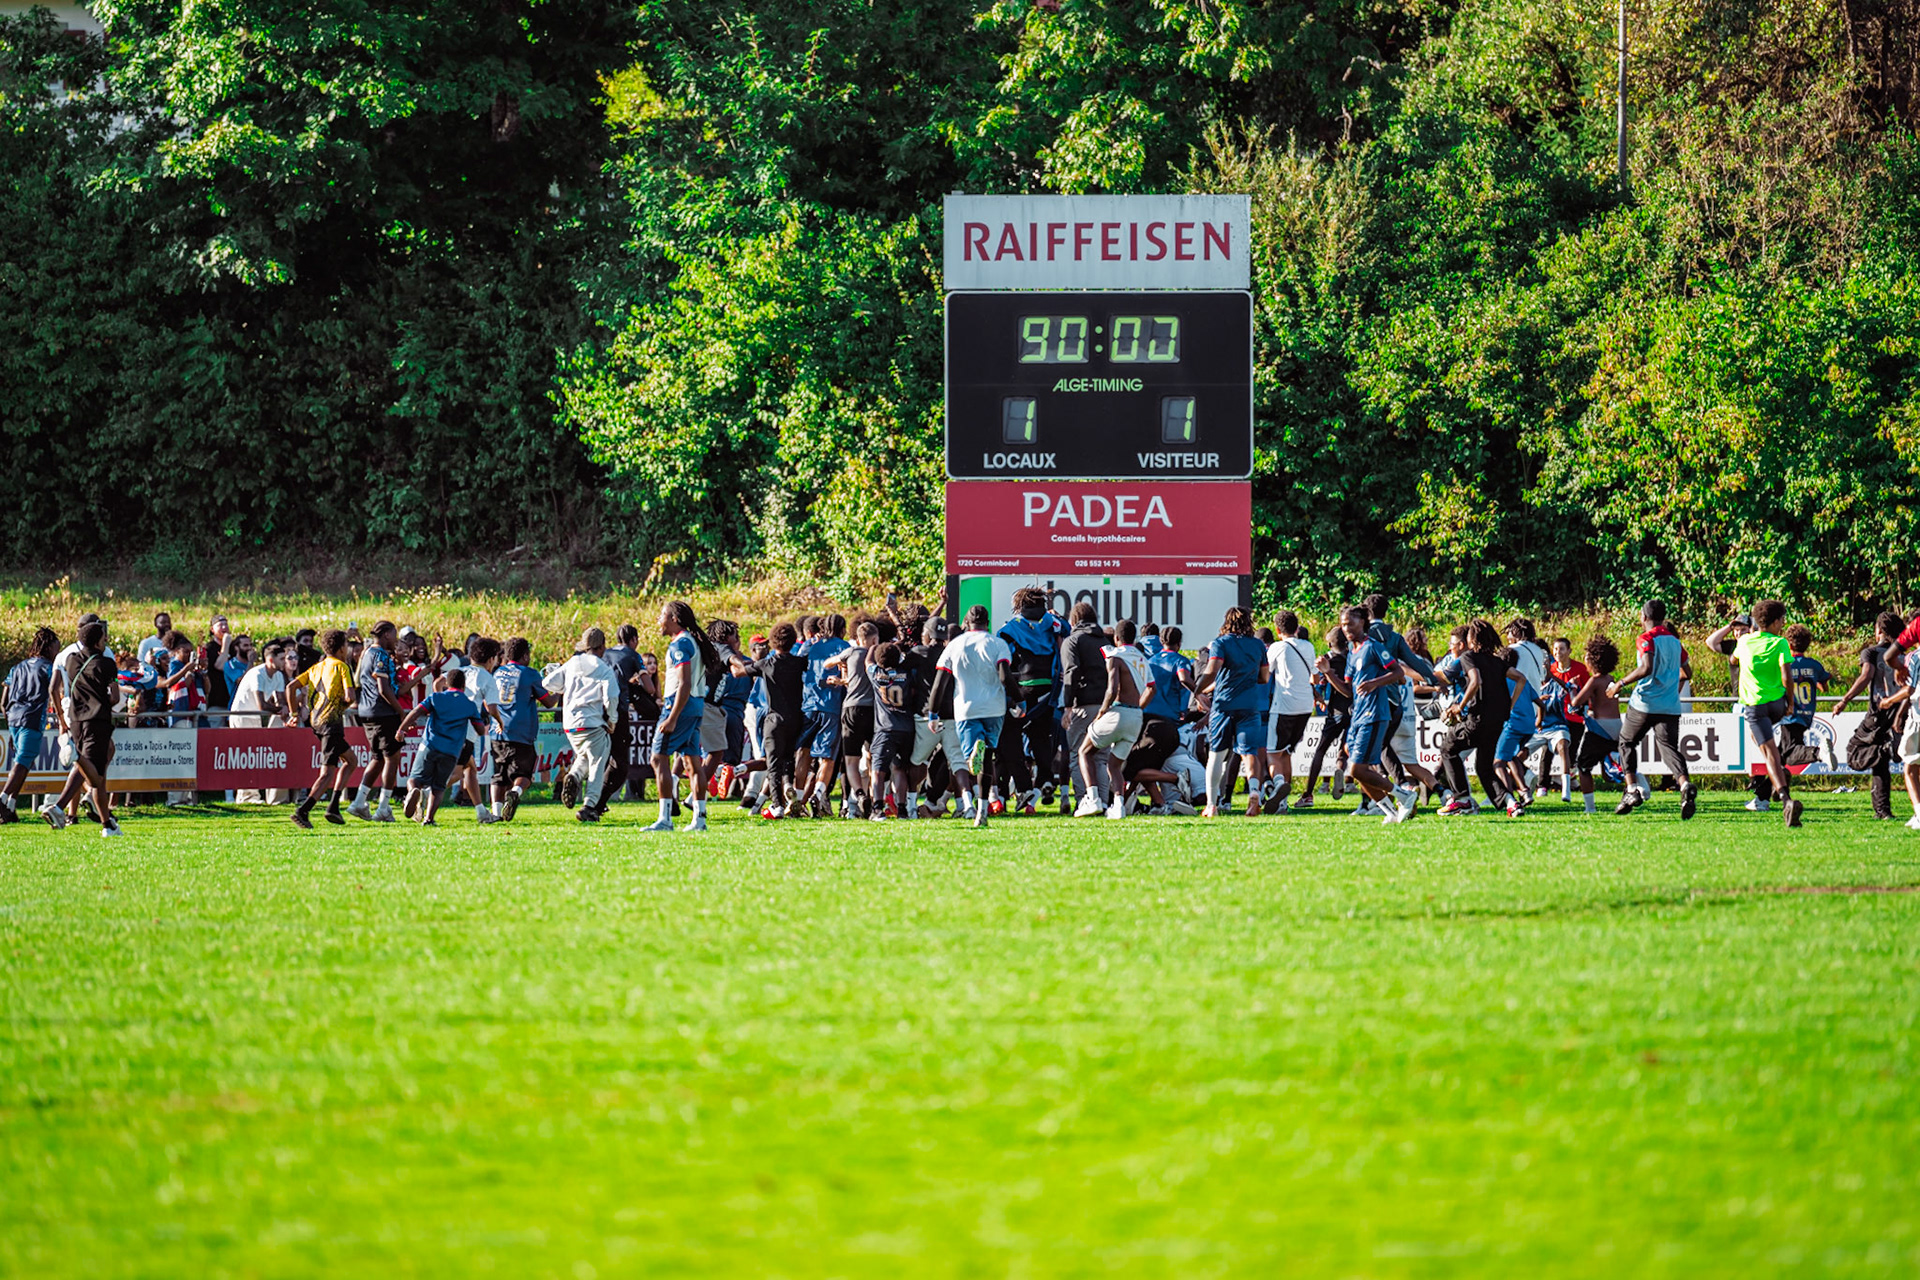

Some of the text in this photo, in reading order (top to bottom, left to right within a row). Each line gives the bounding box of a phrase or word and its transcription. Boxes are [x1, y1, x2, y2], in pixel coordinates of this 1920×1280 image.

[963, 222, 1231, 261] RAIFFEISEN
[1052, 378, 1144, 392] ALGE-TIMING
[983, 453, 1057, 469] LOCAUX
[1137, 453, 1220, 468] VISITEUR
[1022, 491, 1173, 528] PADEA
[1051, 534, 1146, 544] Conseils hypothécaires
[957, 559, 1020, 567] 1720 Corminboeuf
[1103, 559, 1111, 567] 14
[1112, 559, 1121, 567] 75
[1185, 560, 1238, 569] www.padea.ch
[124, 741, 131, 751] de
[132, 741, 143, 751] sols
[149, 740, 163, 753] Tapis
[168, 740, 192, 753] Parquets
[150, 755, 172, 765] Rideaux
[178, 755, 194, 765] Stores
[213, 746, 287, 770] la Mobilière
